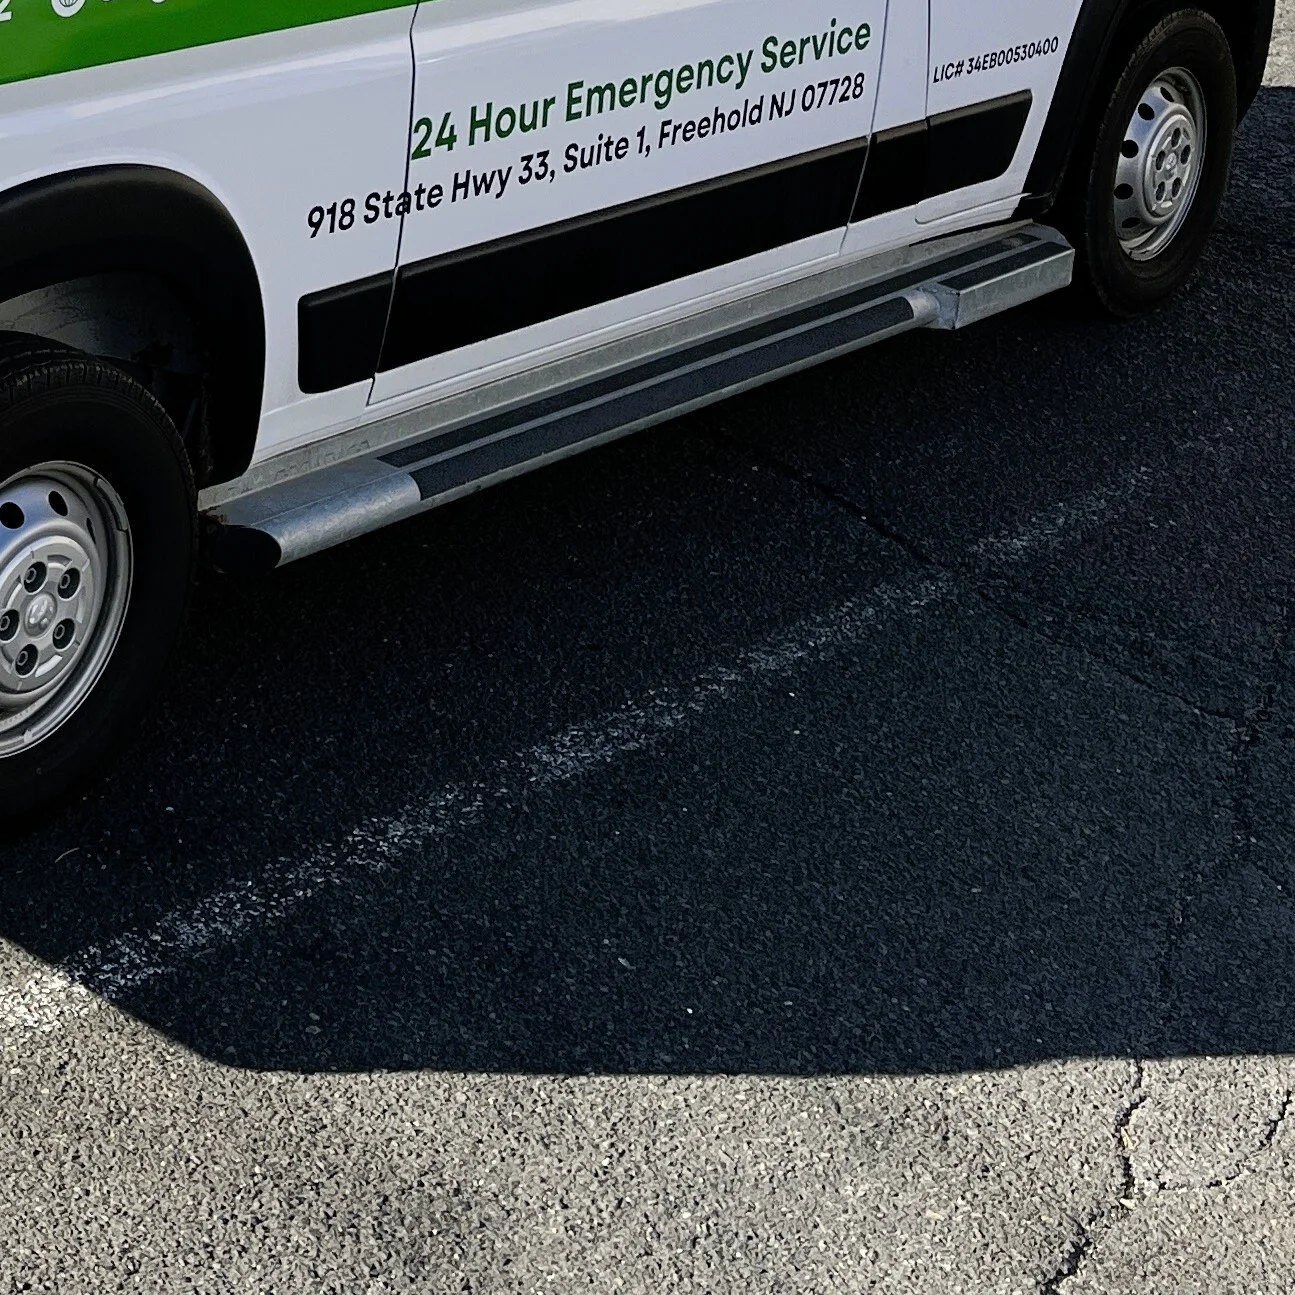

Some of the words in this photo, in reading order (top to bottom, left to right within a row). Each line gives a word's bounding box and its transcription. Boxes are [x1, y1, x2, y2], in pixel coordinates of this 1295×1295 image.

[411, 112, 457, 160] 24
[468, 96, 556, 146] Hour
[565, 49, 754, 122] Emergency
[760, 17, 871, 73] Service
[933, 60, 965, 83] LIC#
[966, 36, 1059, 75] 34EB00530400
[307, 198, 355, 238] 918
[363, 183, 443, 224] State
[451, 166, 512, 202] Hwy
[519, 150, 556, 185] 33,
[563, 133, 629, 173] Suite
[636, 125, 651, 158] 1,
[658, 95, 765, 149] Freehold
[769, 88, 796, 121] NJ
[801, 72, 865, 113] 07728
